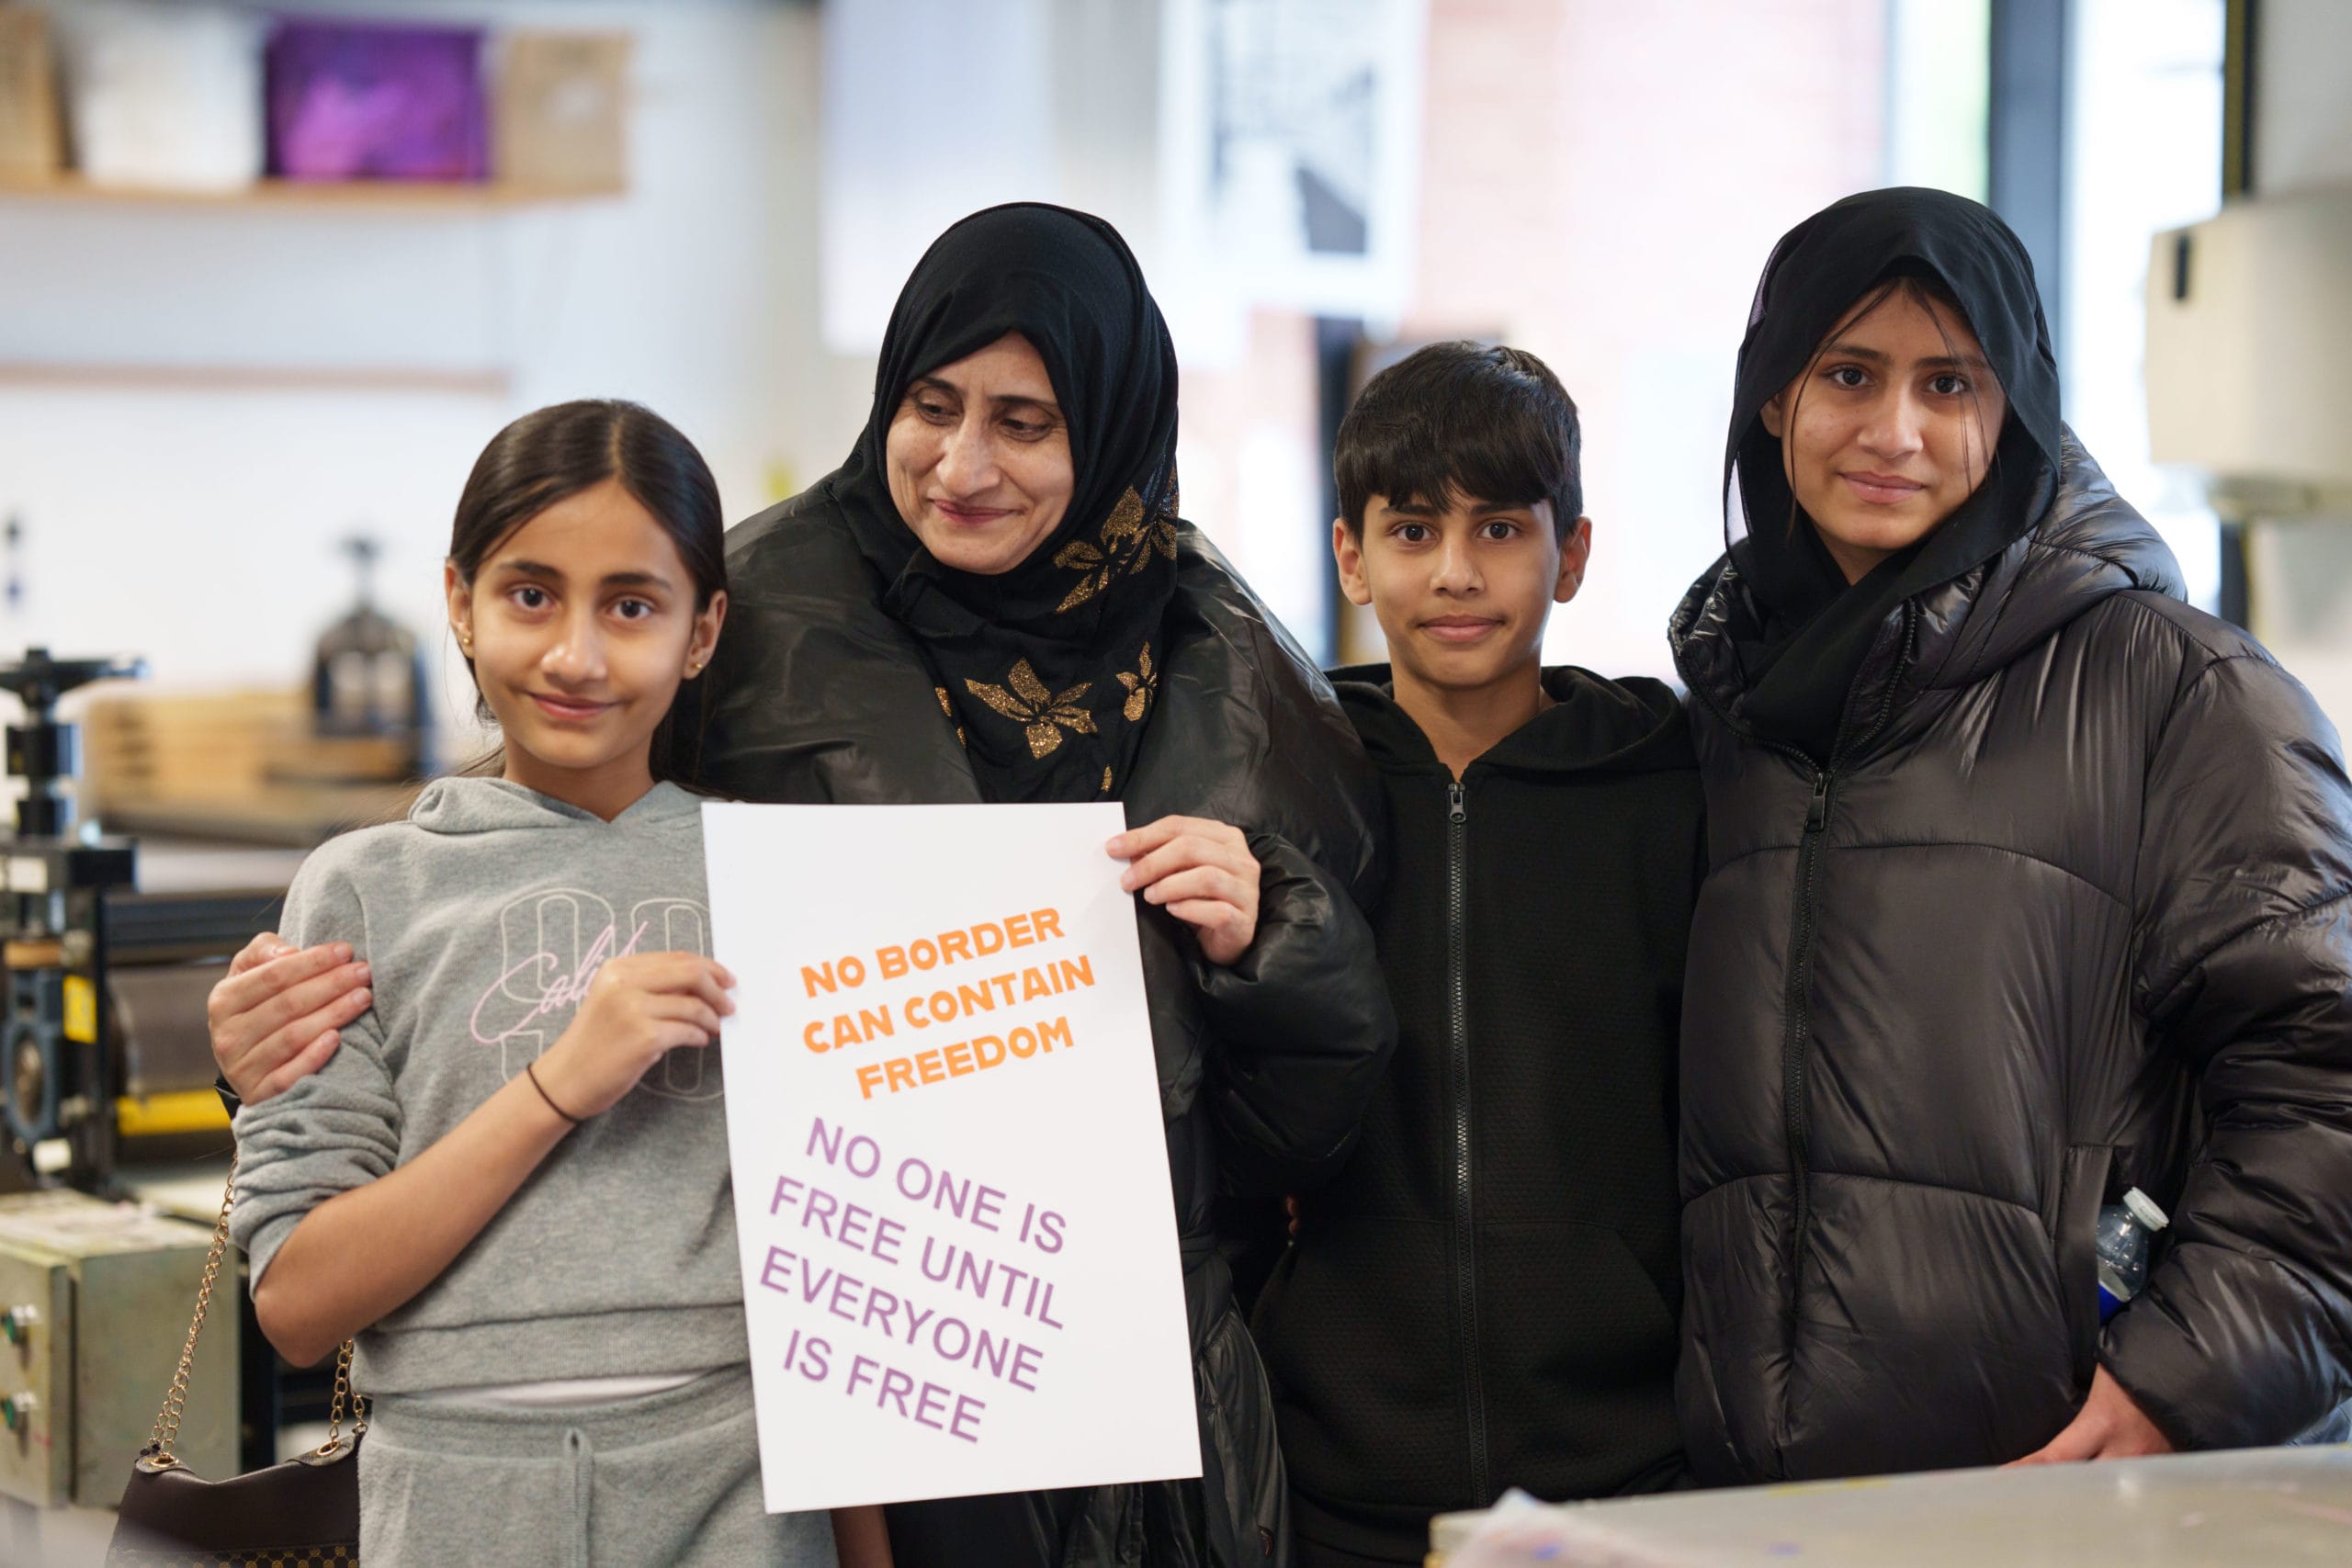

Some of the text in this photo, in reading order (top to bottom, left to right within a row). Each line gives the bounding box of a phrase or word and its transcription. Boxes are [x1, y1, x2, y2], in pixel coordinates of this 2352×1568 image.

[800, 908, 1065, 998] NO BORDER
[803, 954, 1095, 1054] CAN CONTAIN
[855, 1016, 1073, 1100] FREEDOM
[806, 1117, 1067, 1255] NO ONE IS
[768, 1175, 1064, 1330] FREE UNTIL
[759, 1246, 1044, 1392] EVERYONE
[783, 1329, 986, 1443] IS FREE
